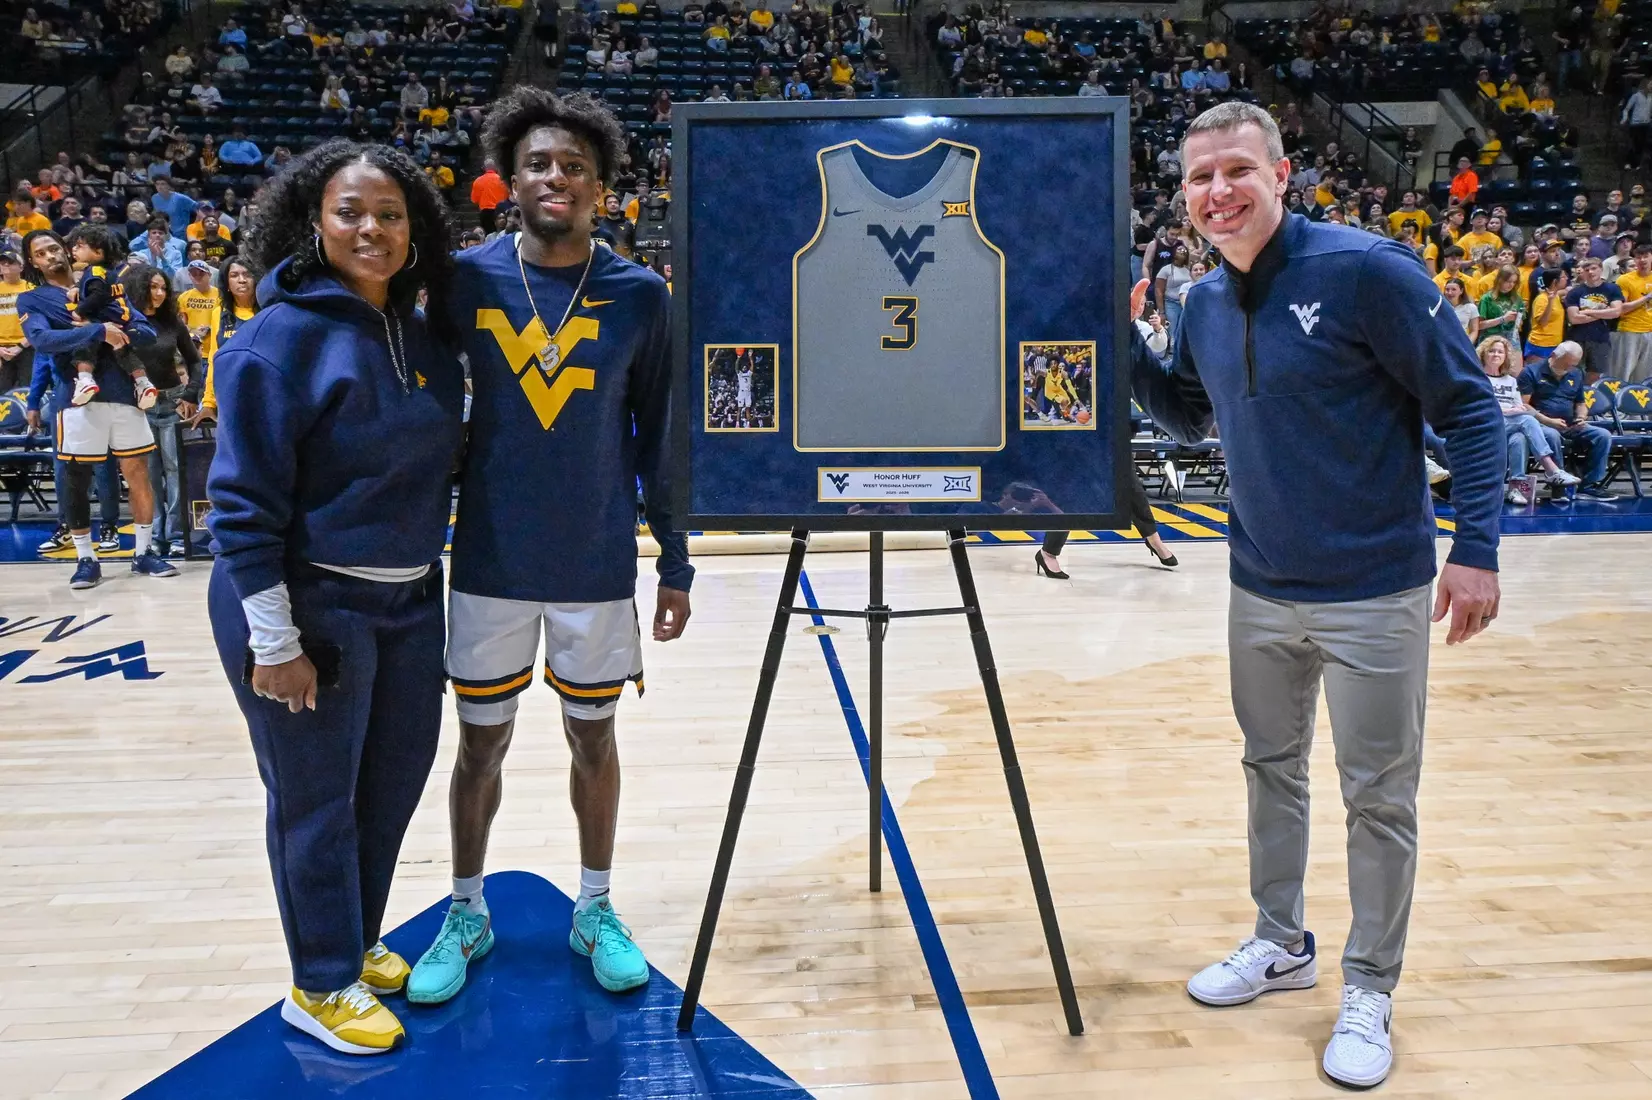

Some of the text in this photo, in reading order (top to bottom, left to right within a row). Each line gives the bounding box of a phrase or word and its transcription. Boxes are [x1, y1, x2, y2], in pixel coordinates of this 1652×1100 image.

[942, 201, 970, 218] XII
[867, 224, 935, 287] WV
[880, 295, 918, 351] 3
[1288, 302, 1322, 336] WV
[475, 308, 600, 431] WV
